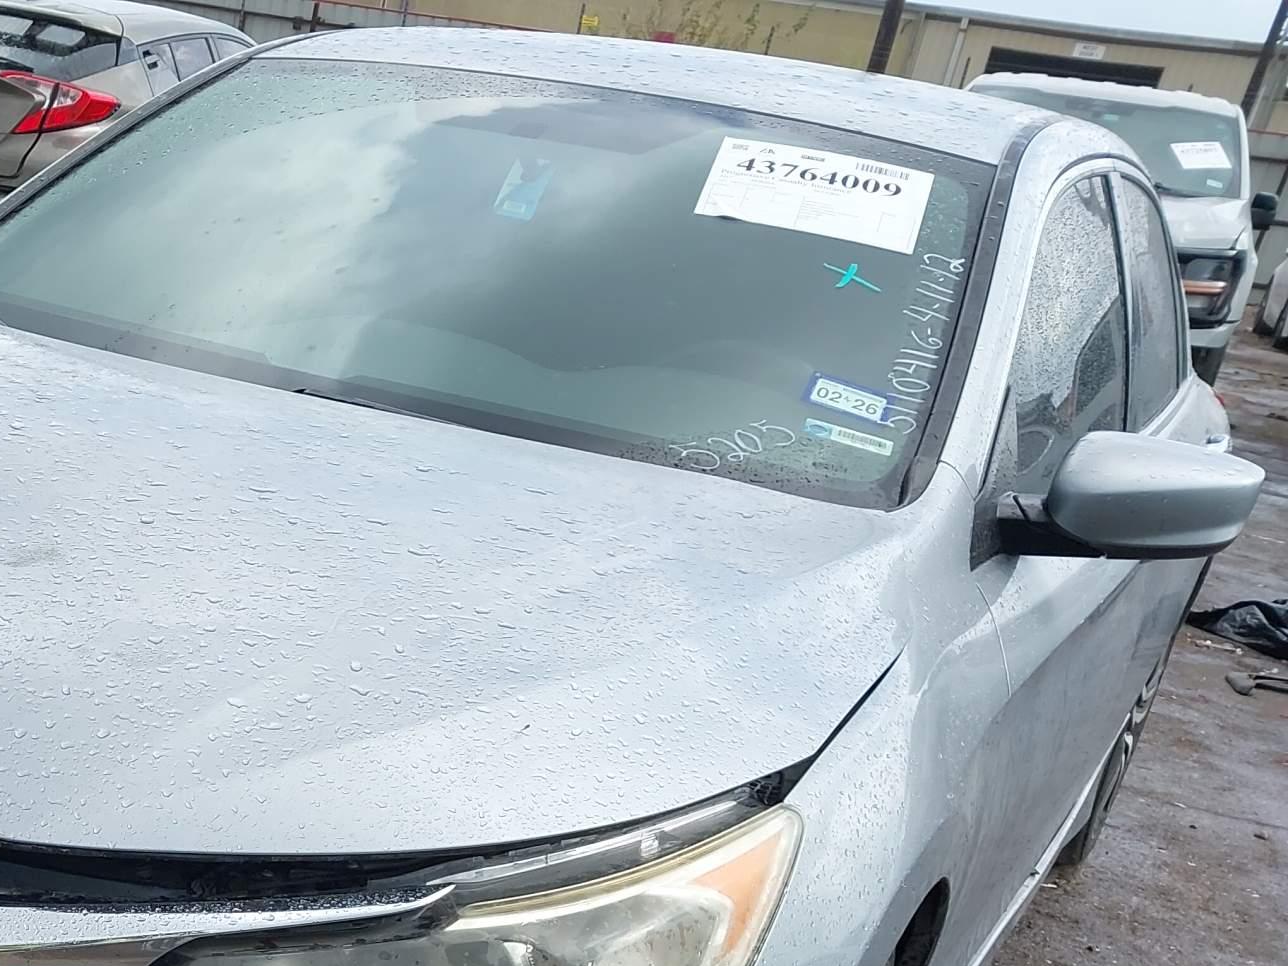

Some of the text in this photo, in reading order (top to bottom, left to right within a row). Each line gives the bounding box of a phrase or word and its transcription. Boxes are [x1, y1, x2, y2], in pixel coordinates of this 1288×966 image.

[736, 157, 903, 197] 43764009
[816, 386, 879, 415] 02 26
[668, 419, 796, 470] 5205
